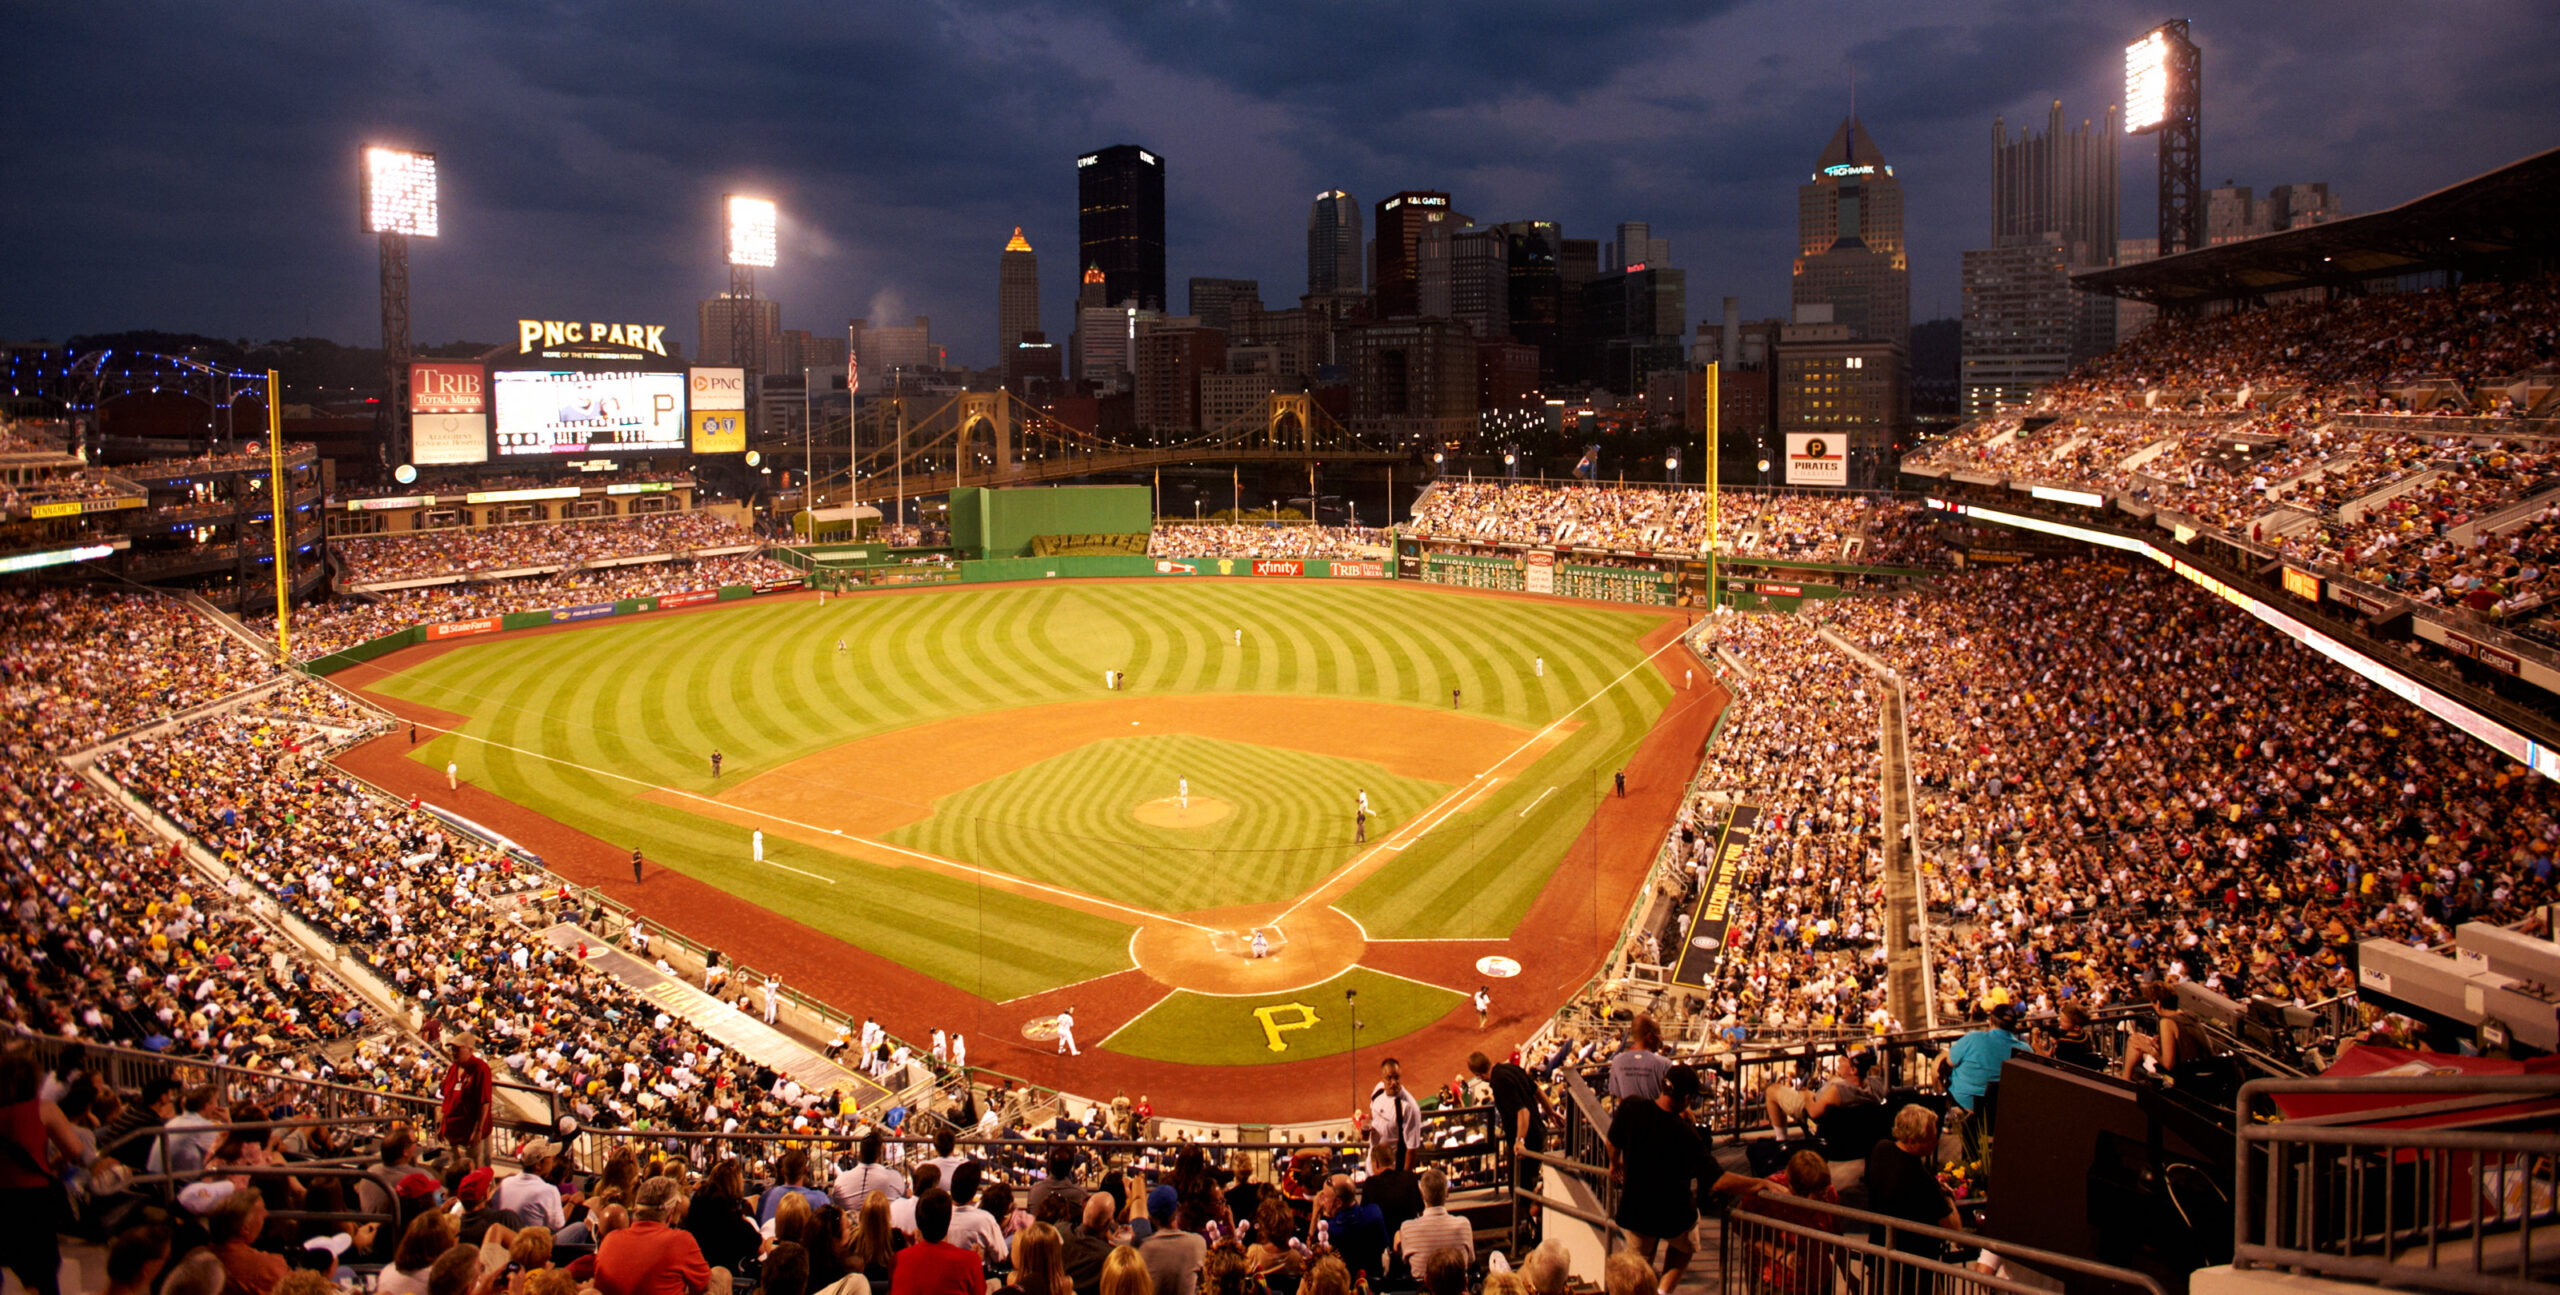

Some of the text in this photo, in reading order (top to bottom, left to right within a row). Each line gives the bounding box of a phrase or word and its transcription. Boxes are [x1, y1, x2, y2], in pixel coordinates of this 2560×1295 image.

[1078, 155, 1098, 168] UPMC
[1828, 165, 1874, 176] HIGHMARK
[1422, 197, 1446, 206] GATES
[518, 320, 668, 357] PNC PARK
[415, 369, 481, 394] TRIB
[711, 377, 741, 390] PNC
[450, 395, 481, 405] MEDIA
[1794, 461, 1838, 470] PIRATES
[33, 504, 81, 515] KENNAMETAL
[1258, 560, 1298, 576] xfinity
[1330, 562, 1360, 576] TRIB
[1431, 559, 1513, 570] NATIONAL LEAGUE
[1566, 569, 1662, 583] AMERICAN LEAGUE
[449, 623, 471, 632] State
[471, 621, 491, 630] Farm
[2480, 649, 2514, 673] CLEMENTE
[1704, 882, 1732, 921] WELCOME
[644, 983, 731, 1025] PIRATES
[1252, 1001, 1322, 1053] P
